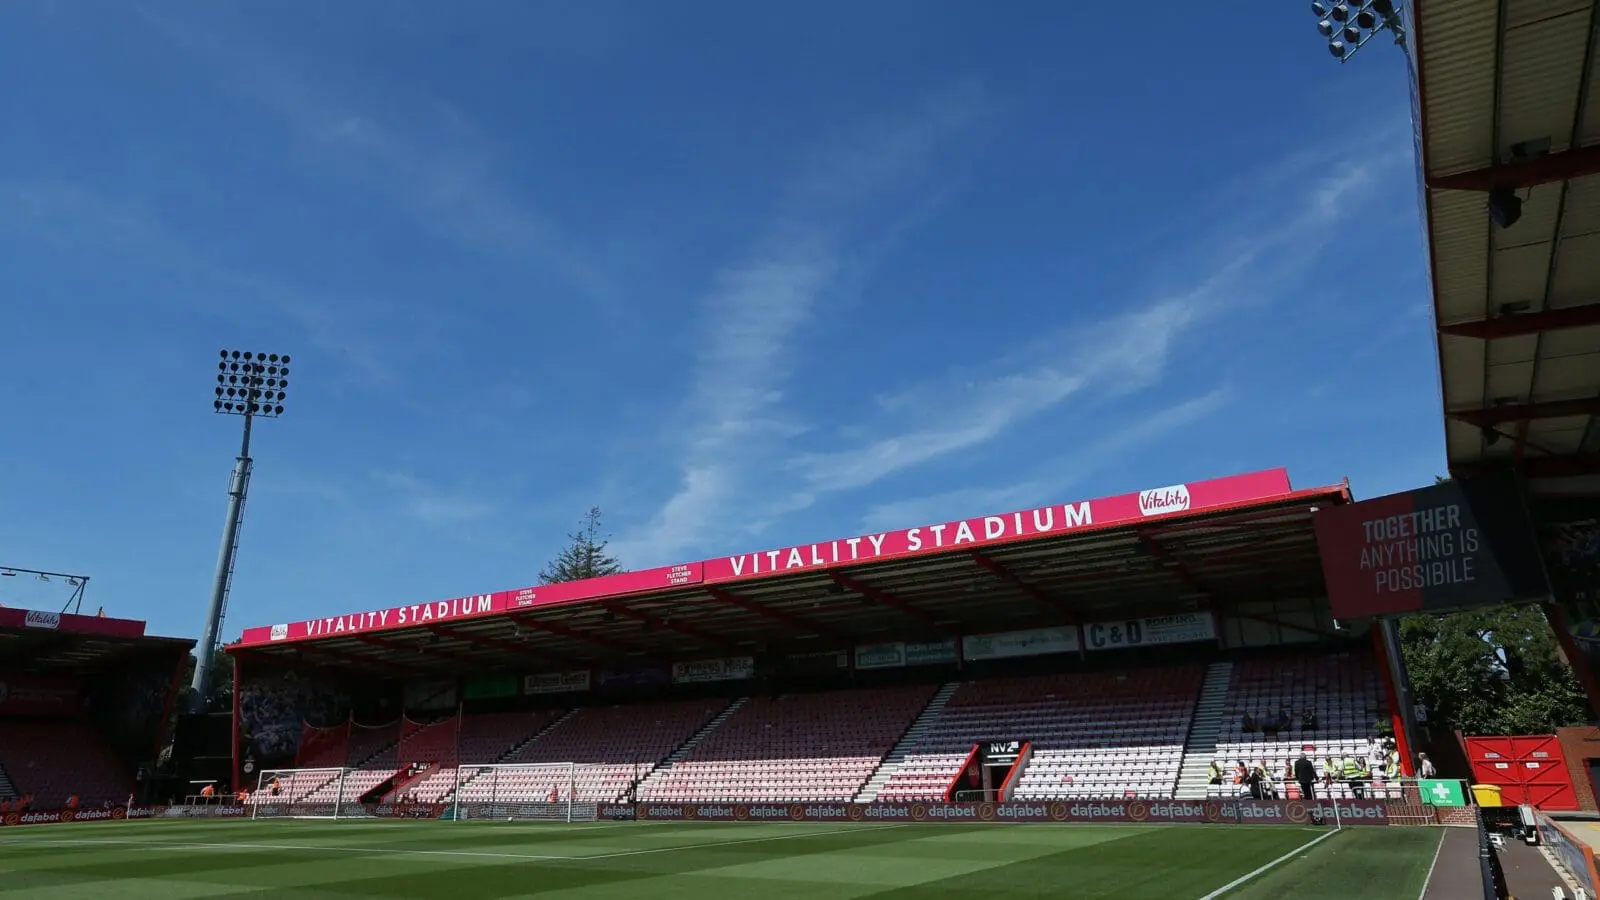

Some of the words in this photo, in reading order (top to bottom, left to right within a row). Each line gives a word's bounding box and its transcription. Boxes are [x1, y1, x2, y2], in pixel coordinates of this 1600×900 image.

[1141, 492, 1188, 511] Vitality
[1362, 504, 1461, 543] TOGETHER
[730, 533, 886, 576] VITALITY
[908, 501, 1093, 551] STADIUM
[1360, 532, 1454, 570] ANYTHING
[1460, 528, 1479, 553] IS
[666, 570, 692, 579] FLETCHER
[671, 565, 688, 573] STEVE
[1375, 557, 1476, 594] POSSIBILE
[671, 577, 688, 585] STAND
[306, 609, 388, 636] VITALITY
[398, 594, 492, 624] STADIUM
[1145, 614, 1196, 627] ROOFING
[1090, 623, 1106, 647] C
[1110, 626, 1122, 643] &
[1126, 620, 1142, 644] D
[990, 743, 1014, 753] NV2
[20, 813, 59, 823] dafabet
[74, 810, 111, 820] dafabet
[602, 803, 635, 817] dafabet
[649, 803, 682, 817] dafabet
[697, 803, 734, 817] dafabet
[749, 803, 787, 817] dafabet
[805, 803, 846, 818] dafabet
[865, 803, 909, 818] dafabet
[928, 803, 976, 819] dafabet
[997, 803, 1047, 818] dafabet
[1070, 802, 1125, 818] dafabet
[1150, 803, 1204, 819] dafabet
